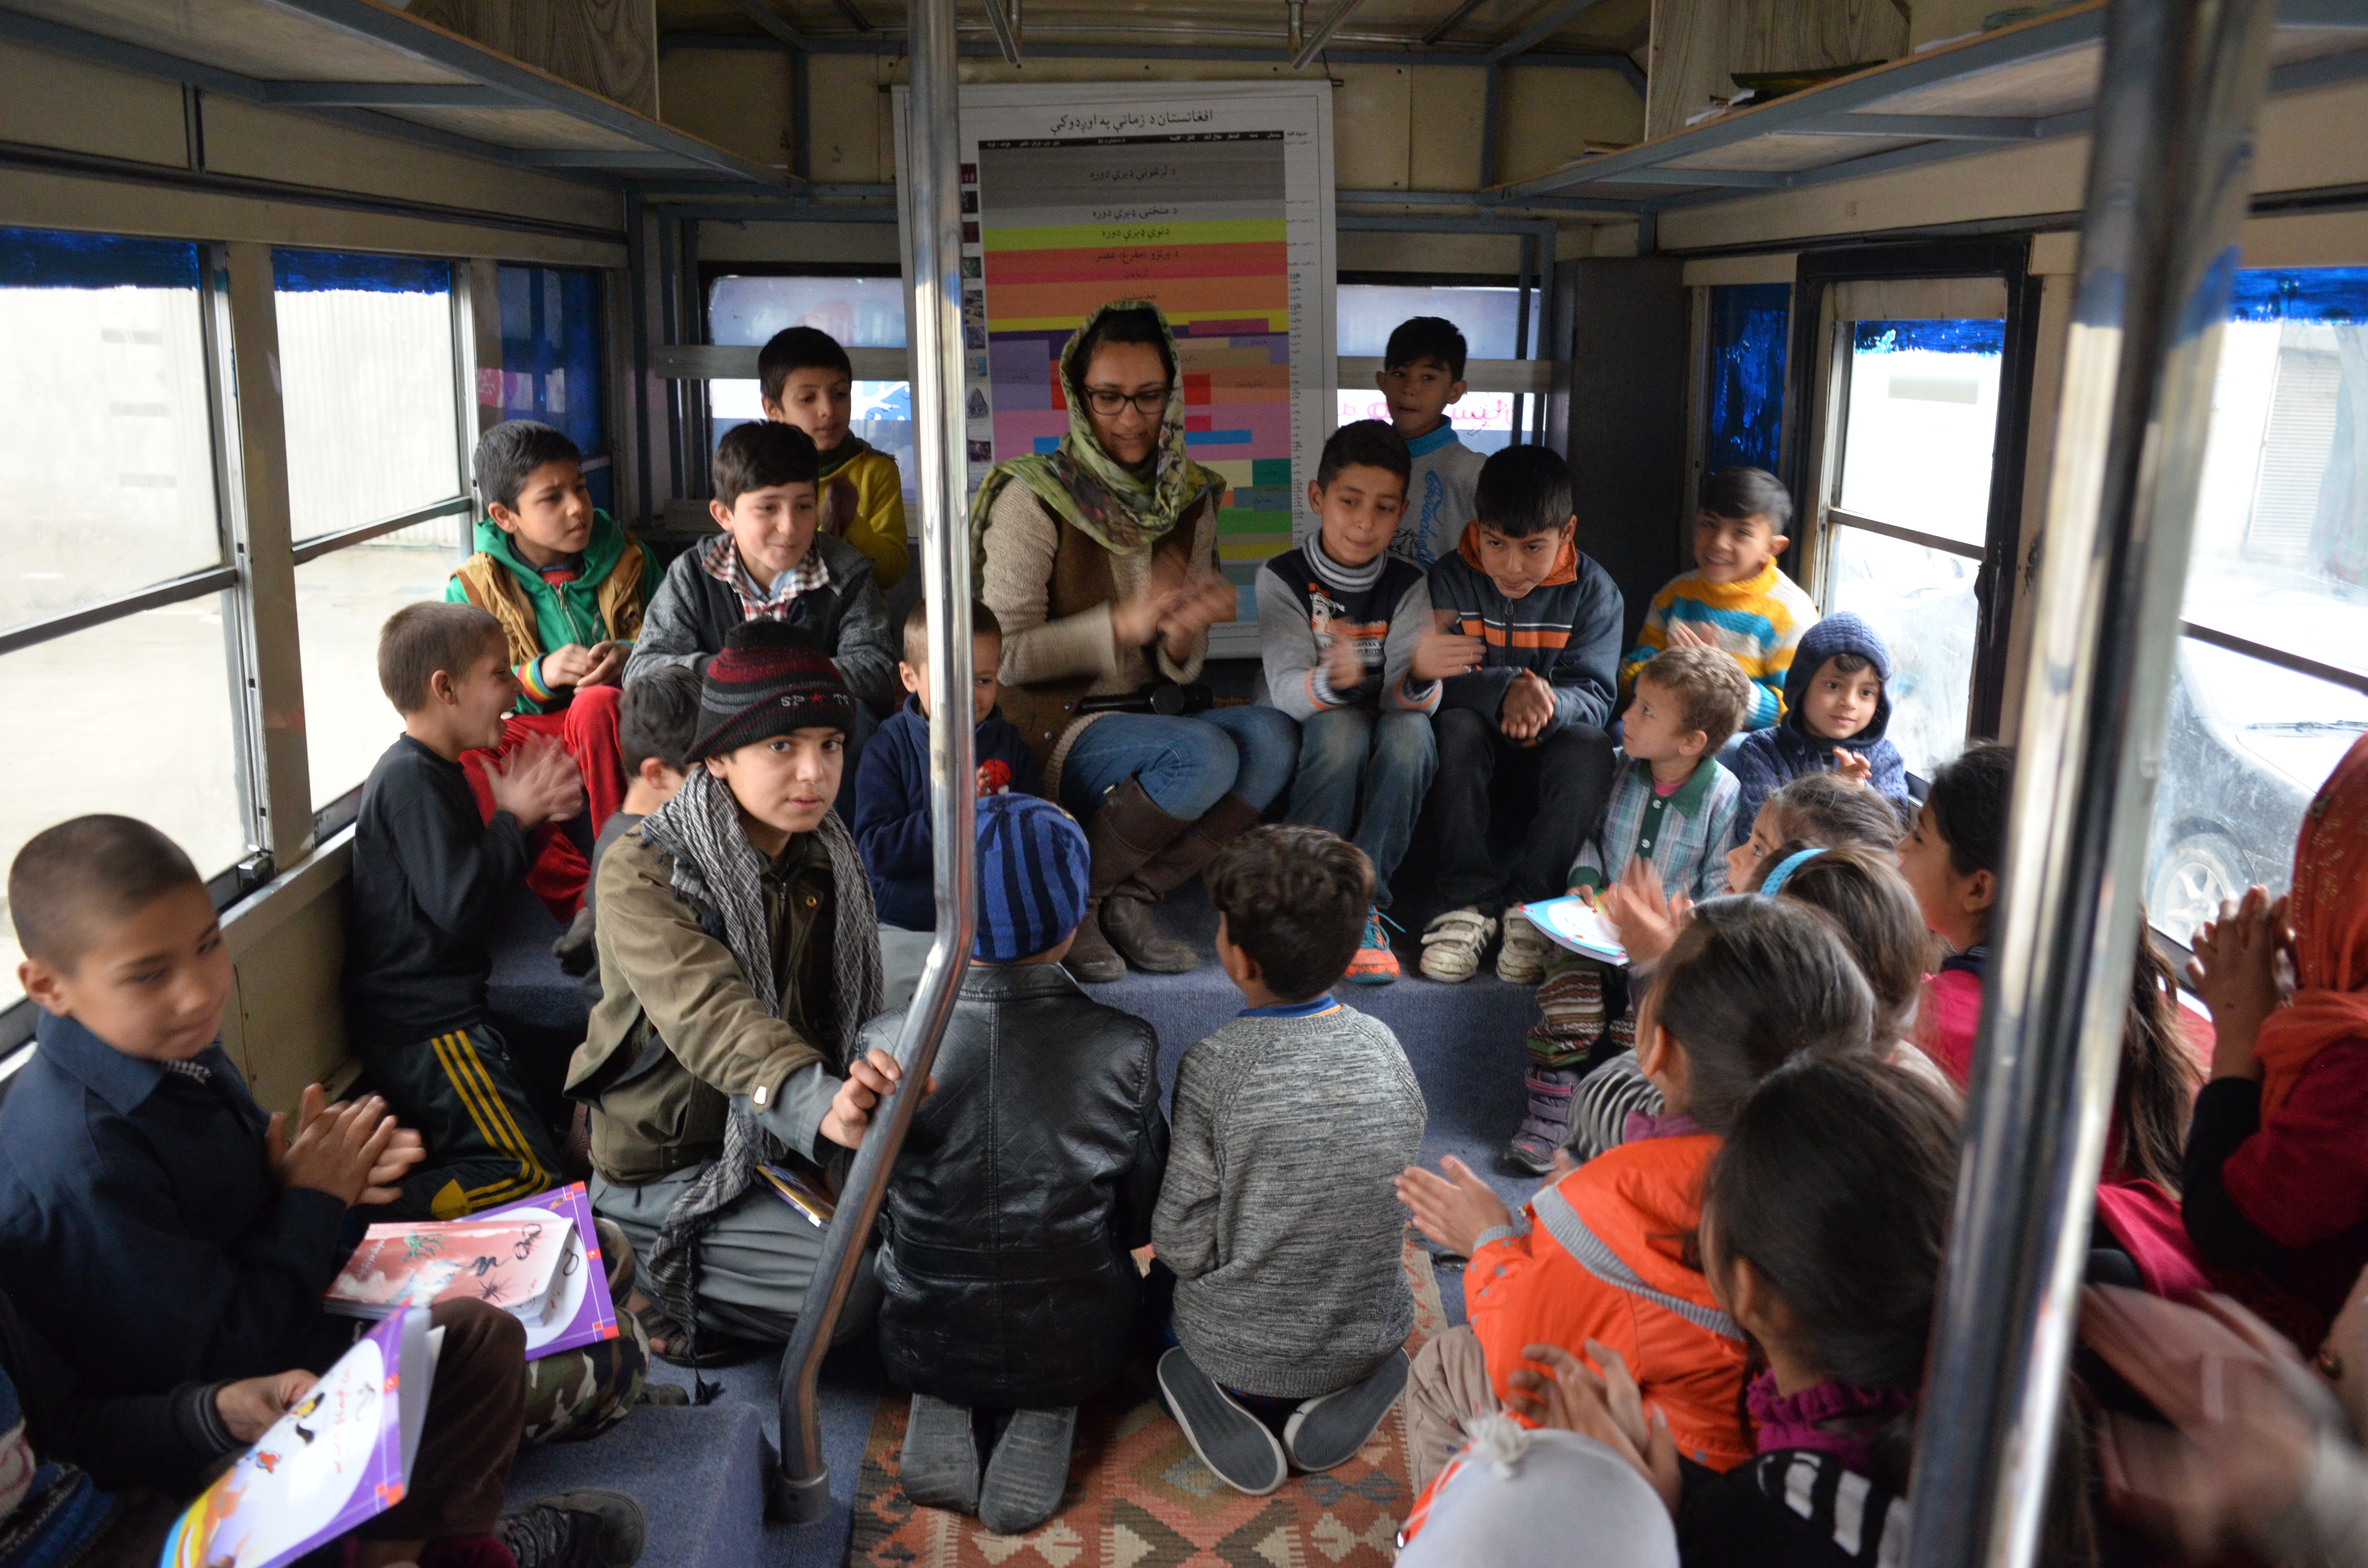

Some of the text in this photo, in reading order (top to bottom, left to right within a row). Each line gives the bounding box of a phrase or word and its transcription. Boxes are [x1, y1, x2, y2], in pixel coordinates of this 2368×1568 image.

[1100, 117, 1110, 130] په
[1150, 115, 1155, 123] د
[1158, 109, 1213, 127] افغانستان
